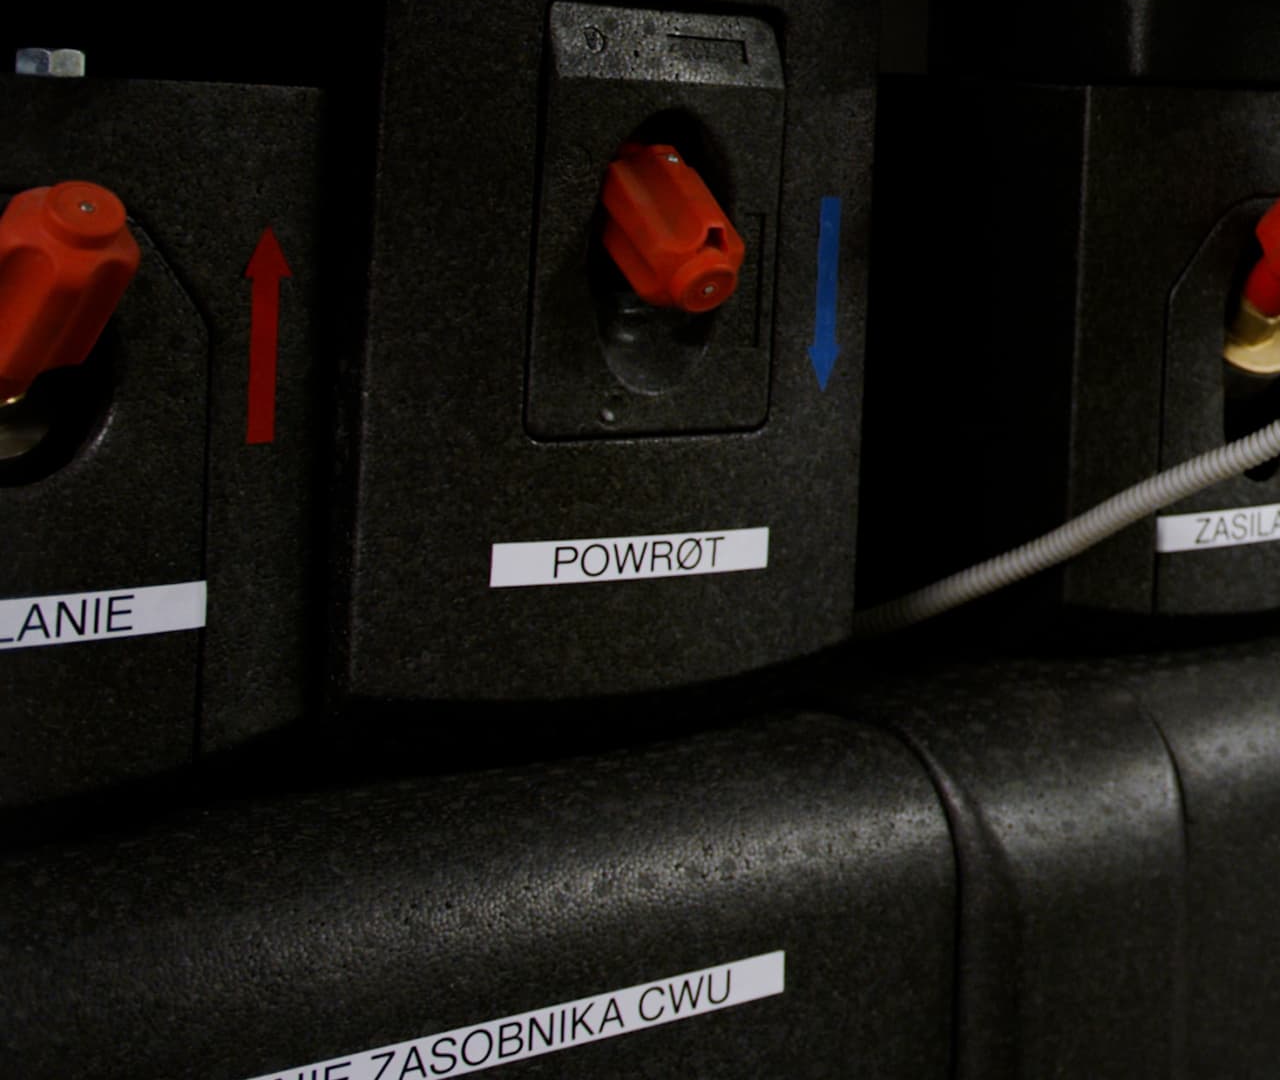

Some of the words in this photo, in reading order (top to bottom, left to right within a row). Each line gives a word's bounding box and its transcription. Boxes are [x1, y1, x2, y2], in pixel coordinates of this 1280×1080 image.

[0, 594, 135, 643] ANIE
[371, 997, 625, 1080] ZASOBNIKA
[637, 969, 733, 1022] CWU
